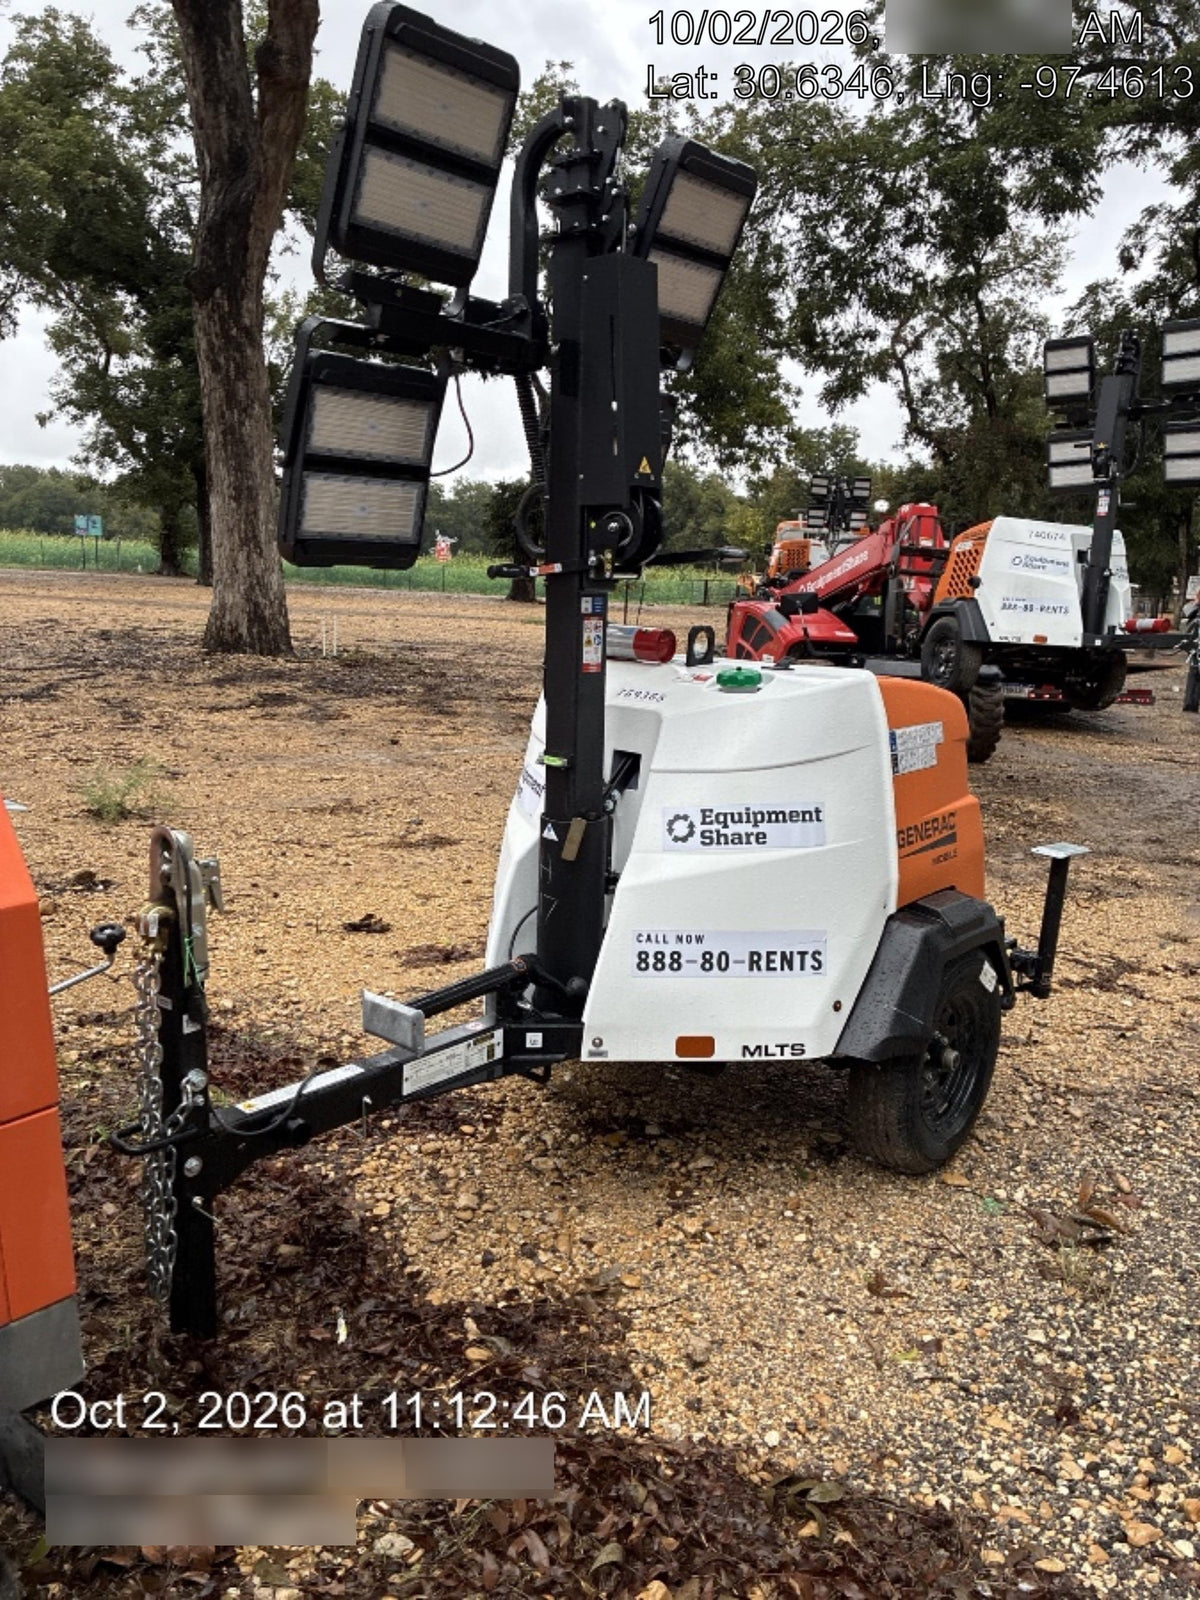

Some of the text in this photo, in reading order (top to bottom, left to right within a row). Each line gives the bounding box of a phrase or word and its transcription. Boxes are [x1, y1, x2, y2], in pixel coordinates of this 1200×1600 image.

[700, 807, 823, 829] Equipment
[700, 829, 768, 846] Share
[897, 811, 957, 849] GENERAC
[636, 933, 705, 945] CALL NOW
[636, 950, 823, 973] 888-80-RENTS
[742, 1043, 806, 1058] MLTS
